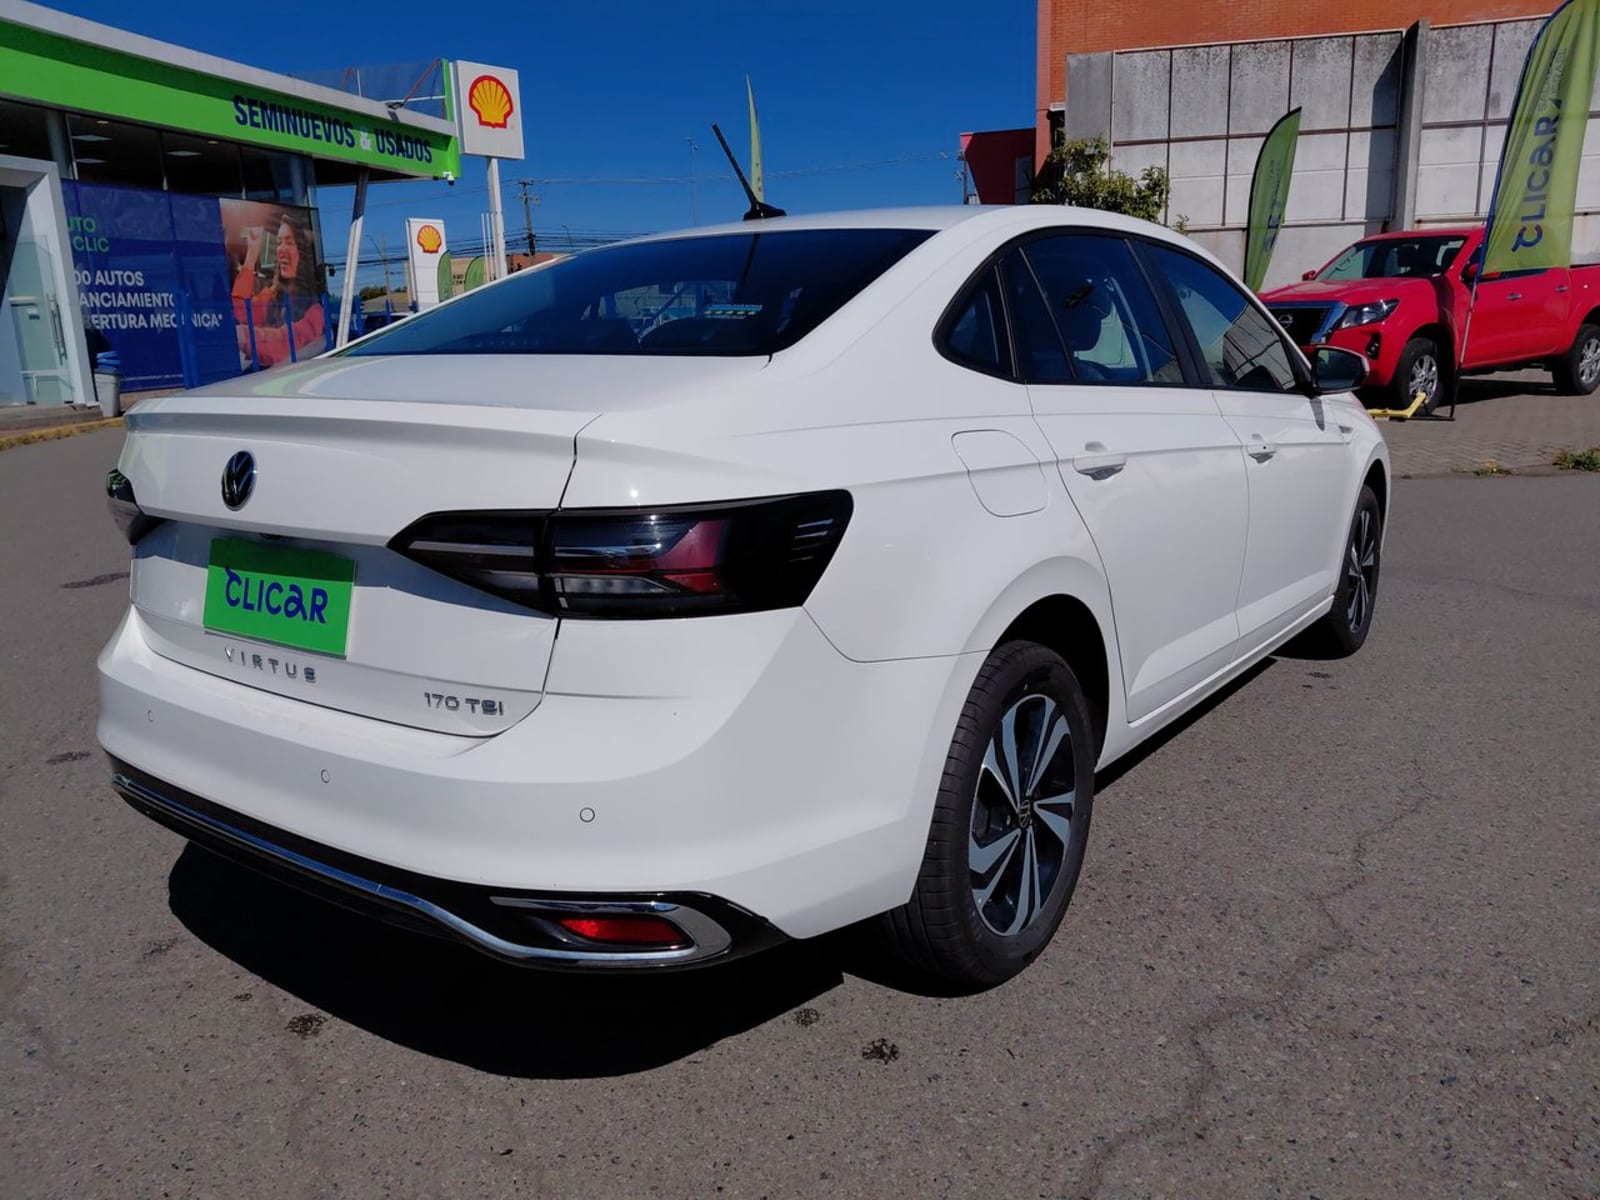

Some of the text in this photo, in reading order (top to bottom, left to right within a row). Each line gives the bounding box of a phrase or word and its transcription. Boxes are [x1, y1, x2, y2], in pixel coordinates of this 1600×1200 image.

[233, 95, 433, 163] SEMINUEVOS & USADOS
[72, 235, 110, 252] CLIC
[95, 270, 145, 286] AUTOS
[224, 647, 317, 683] VIRTUS
[424, 692, 504, 716] 170 TSI
